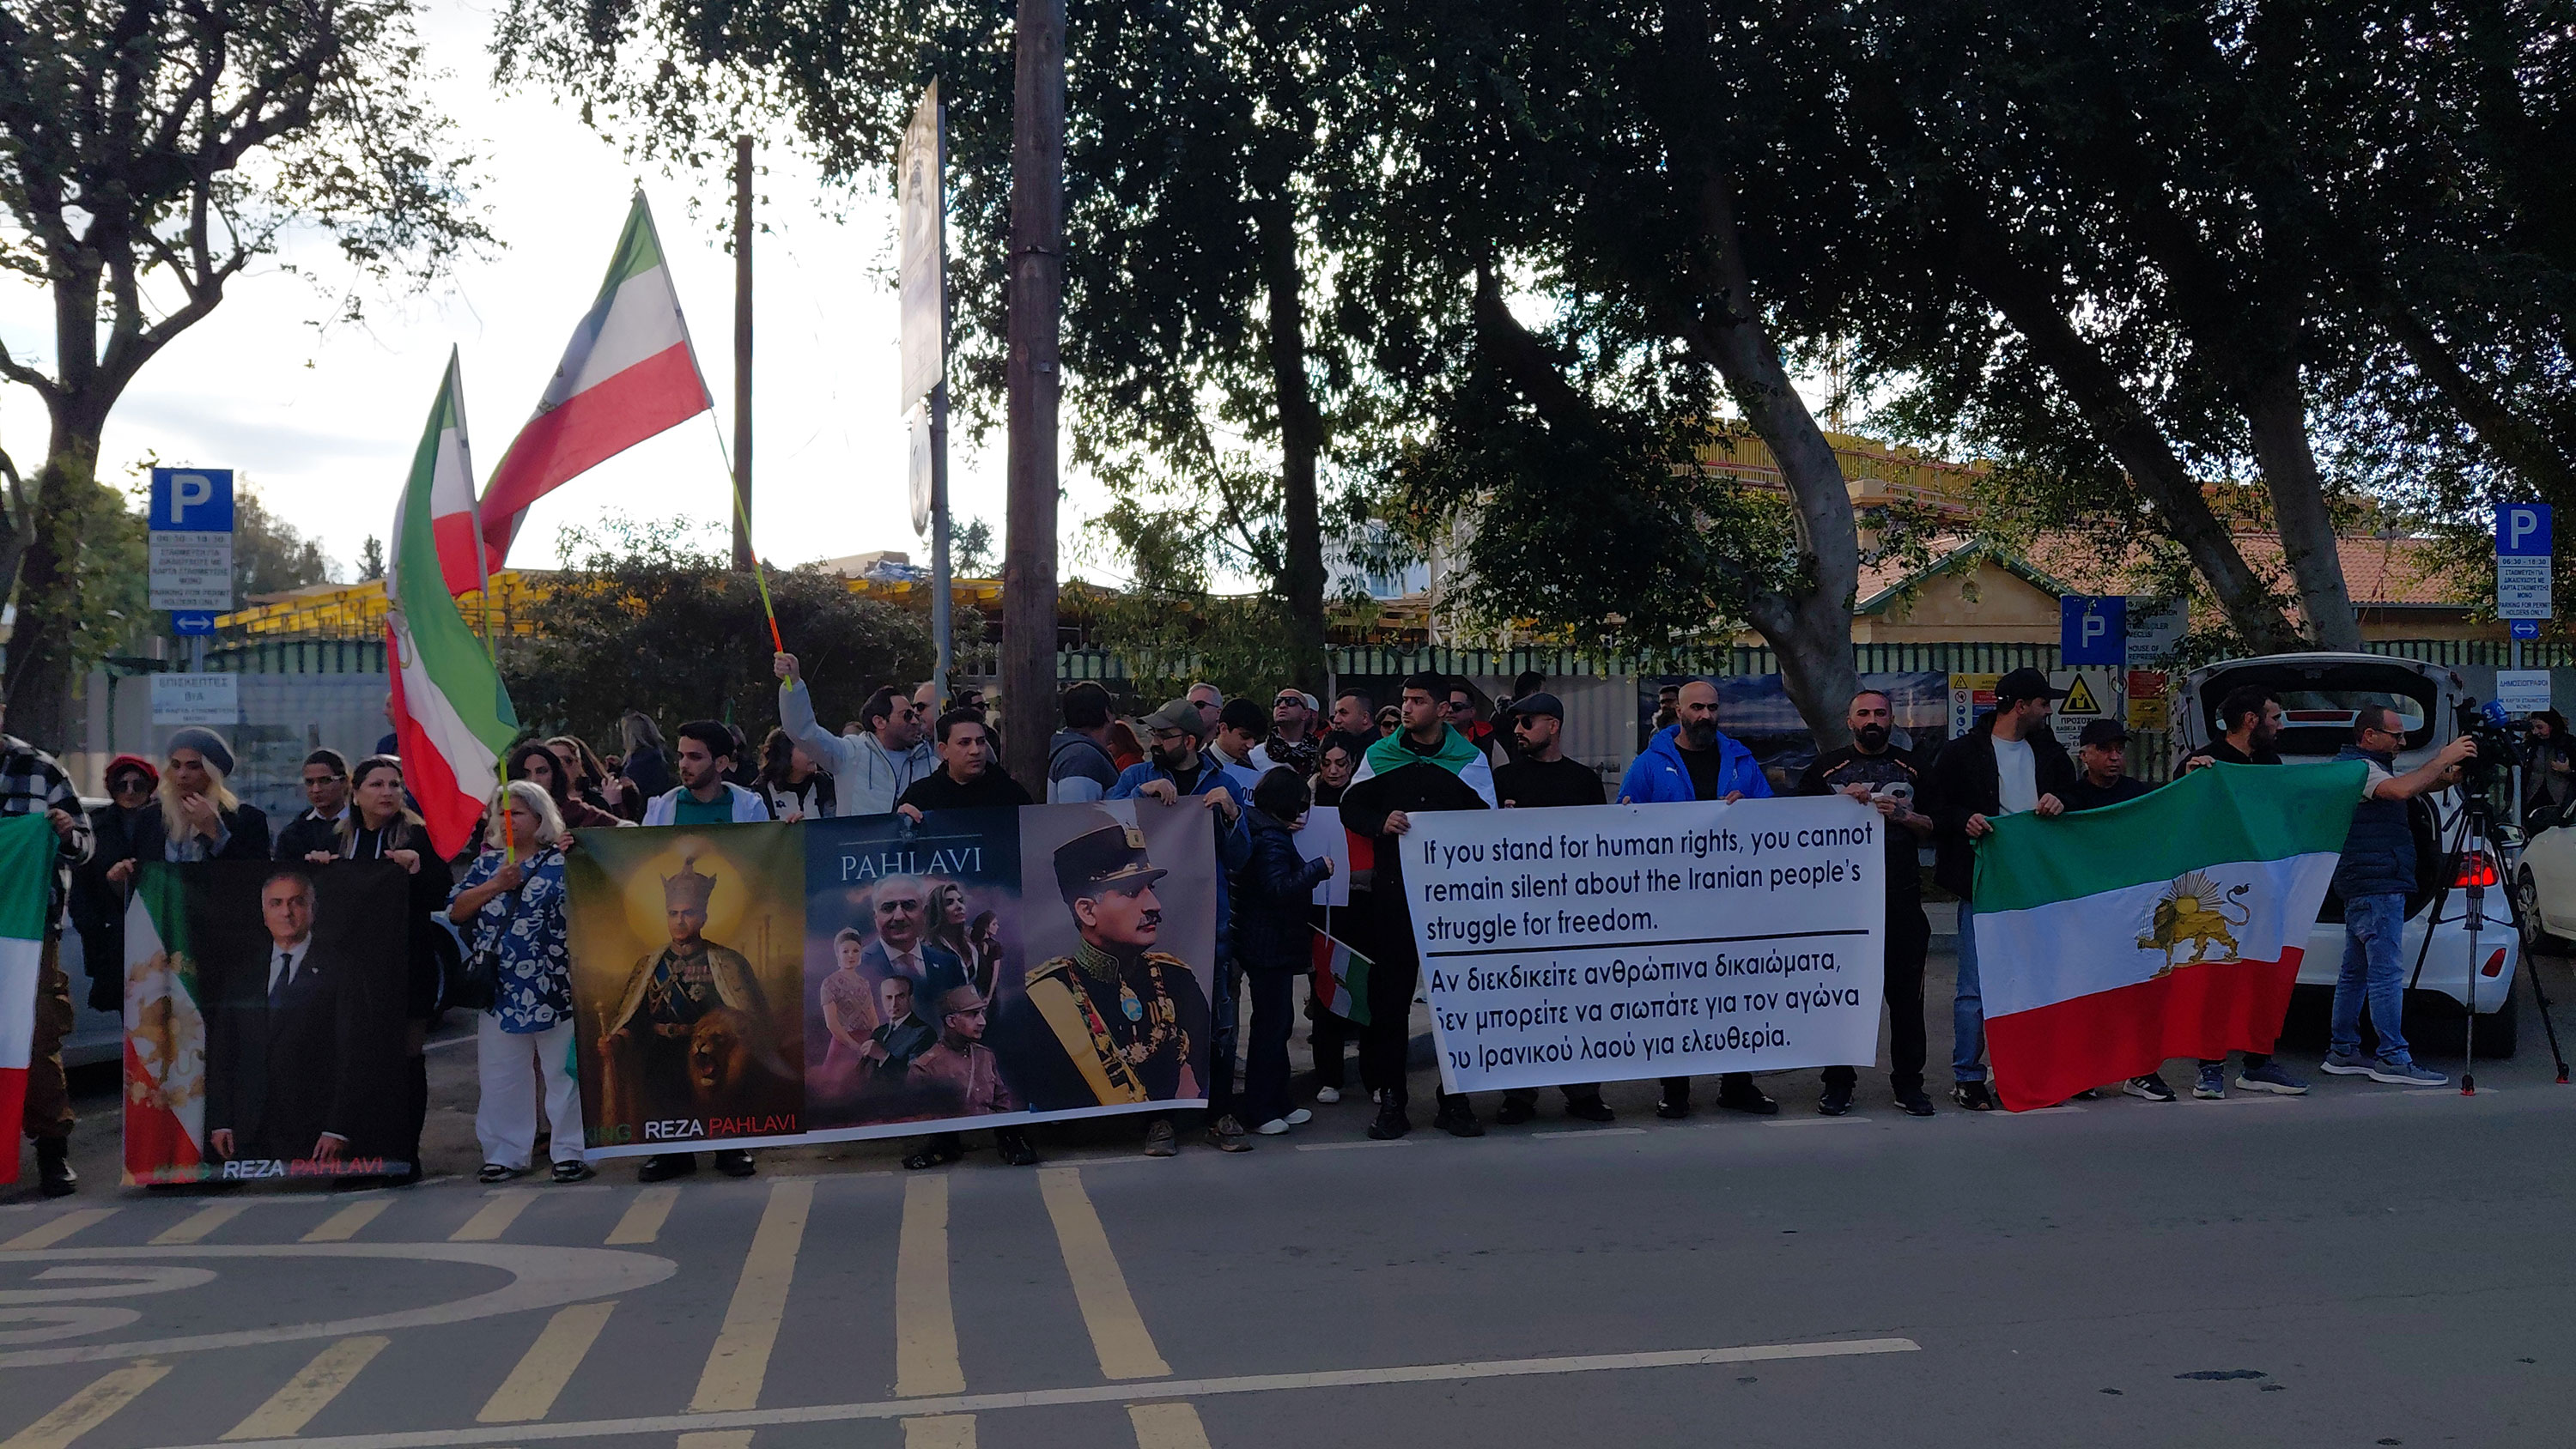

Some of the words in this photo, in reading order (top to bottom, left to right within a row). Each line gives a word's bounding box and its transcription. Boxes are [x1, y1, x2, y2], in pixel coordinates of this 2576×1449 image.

[171, 475, 211, 524] P
[2511, 509, 2537, 549] P
[2082, 615, 2105, 648] P
[841, 847, 982, 882] PAHLAVI
[1424, 840, 1437, 864] If
[1443, 844, 1484, 870] you
[1492, 835, 1553, 862] stand
[1559, 834, 1589, 859] for
[1595, 834, 1674, 858] human
[1680, 828, 1744, 859] rights,
[1750, 831, 1789, 856] you
[1796, 821, 1873, 848] cannot
[1425, 875, 1504, 902] remain
[1511, 872, 1568, 899] silent
[1575, 870, 1641, 895] about
[1646, 868, 1681, 893] the
[1688, 864, 1763, 890] Iranian
[1770, 858, 1861, 892] people's
[1427, 912, 1517, 945] struggle
[1522, 911, 1552, 936] for
[1557, 907, 1658, 934] freedom.
[1431, 969, 1460, 993] Αν
[1467, 961, 1578, 991] διεκδικείτε
[1584, 955, 1708, 989] ανθρώπινα
[1715, 948, 1841, 979] δικαιώματα,
[1475, 998, 1569, 1036] μπορείτε
[1575, 1003, 1602, 1022] να
[1610, 991, 1699, 1021] σιωπάτε
[1704, 995, 1736, 1020] για
[1743, 992, 1779, 1012] τον
[1785, 982, 1859, 1014] αγώνα
[1479, 1034, 1573, 1073] Ιρανικού
[1579, 1031, 1636, 1060] λαού
[1642, 1036, 1674, 1062] για
[1681, 1022, 1791, 1054] ελευθερία.
[645, 1119, 704, 1140] REZA
[708, 1114, 797, 1137] PAHLAVI
[222, 1158, 285, 1179] REZA
[290, 1156, 384, 1177] PAHLAVI
